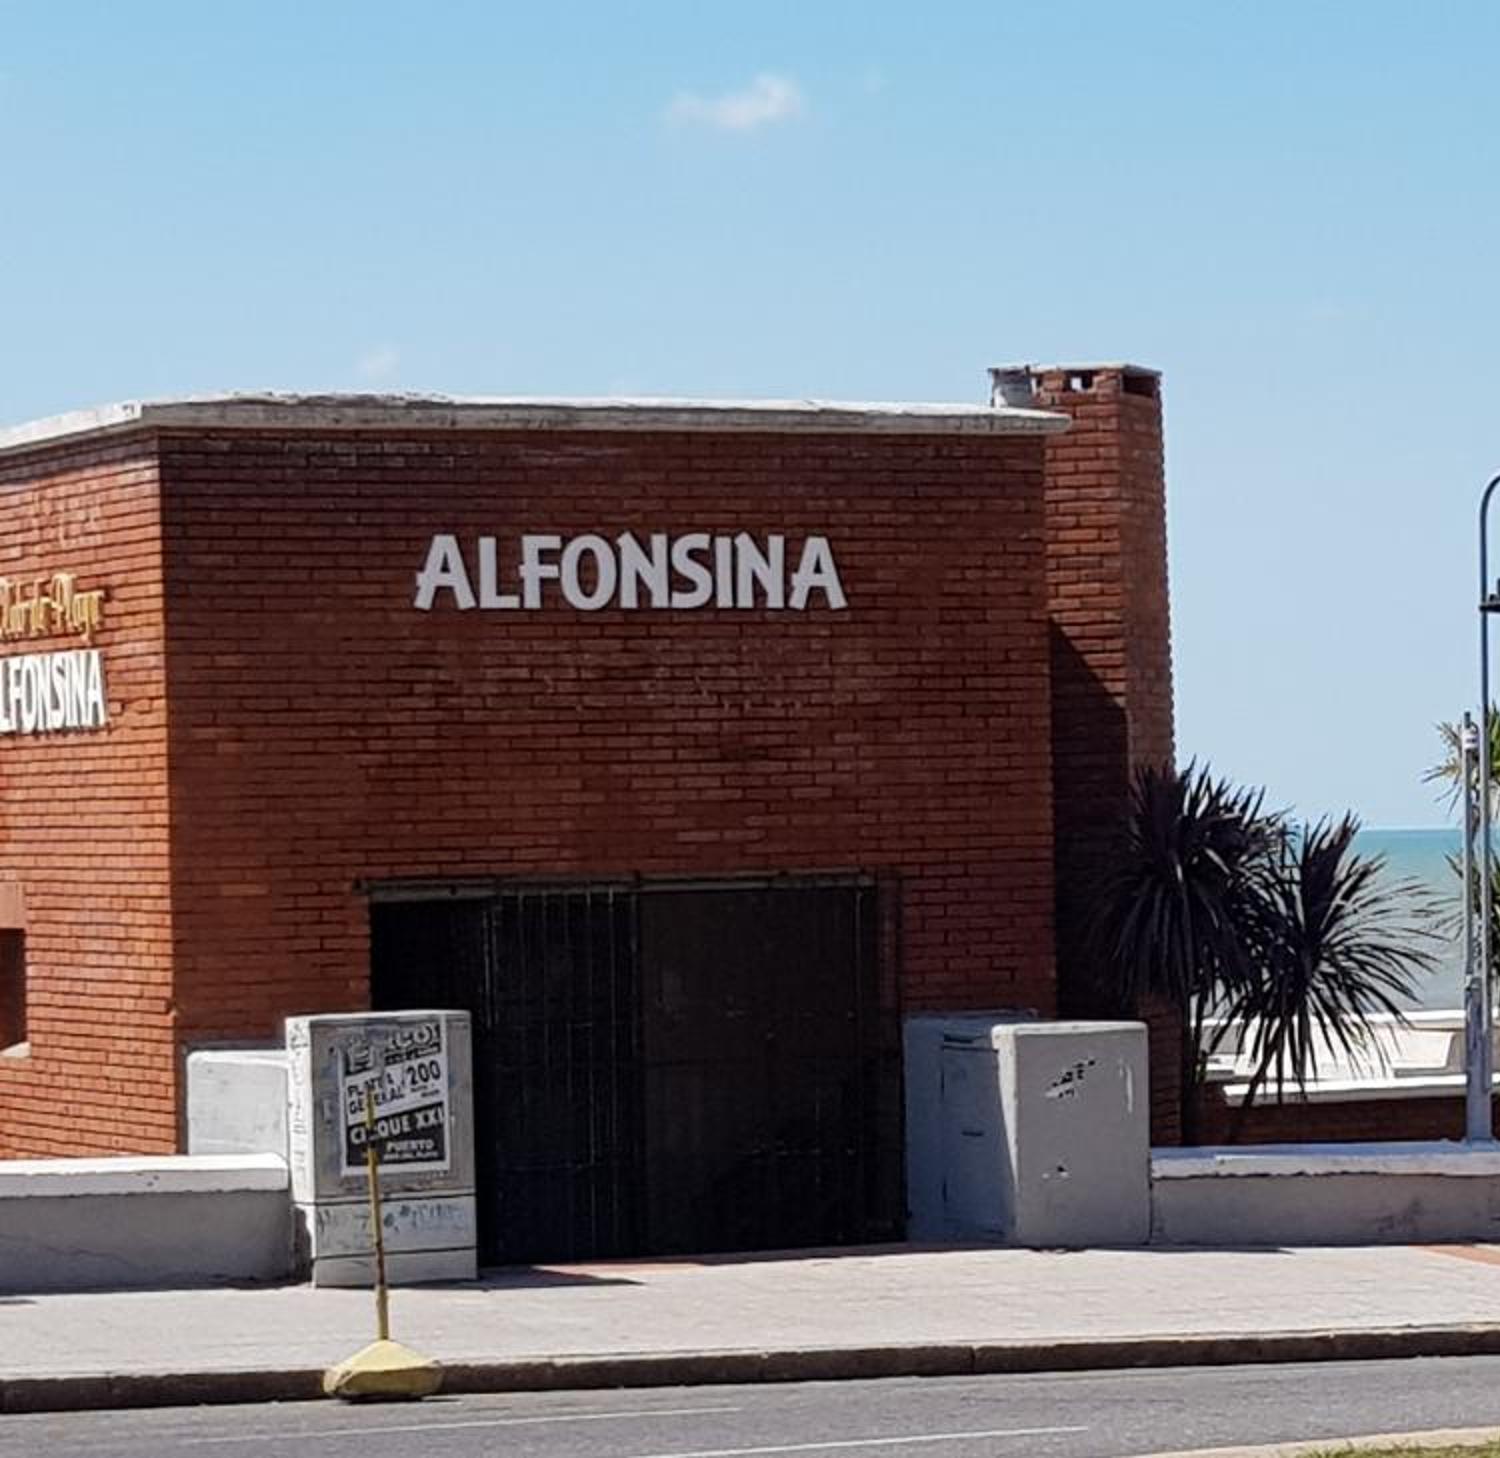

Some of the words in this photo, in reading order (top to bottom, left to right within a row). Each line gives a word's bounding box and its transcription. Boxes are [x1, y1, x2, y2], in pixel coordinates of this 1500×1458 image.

[414, 532, 848, 611] ALFONSINA
[0, 651, 105, 732] LFONSINA
[350, 1087, 405, 1114] GEERAL
